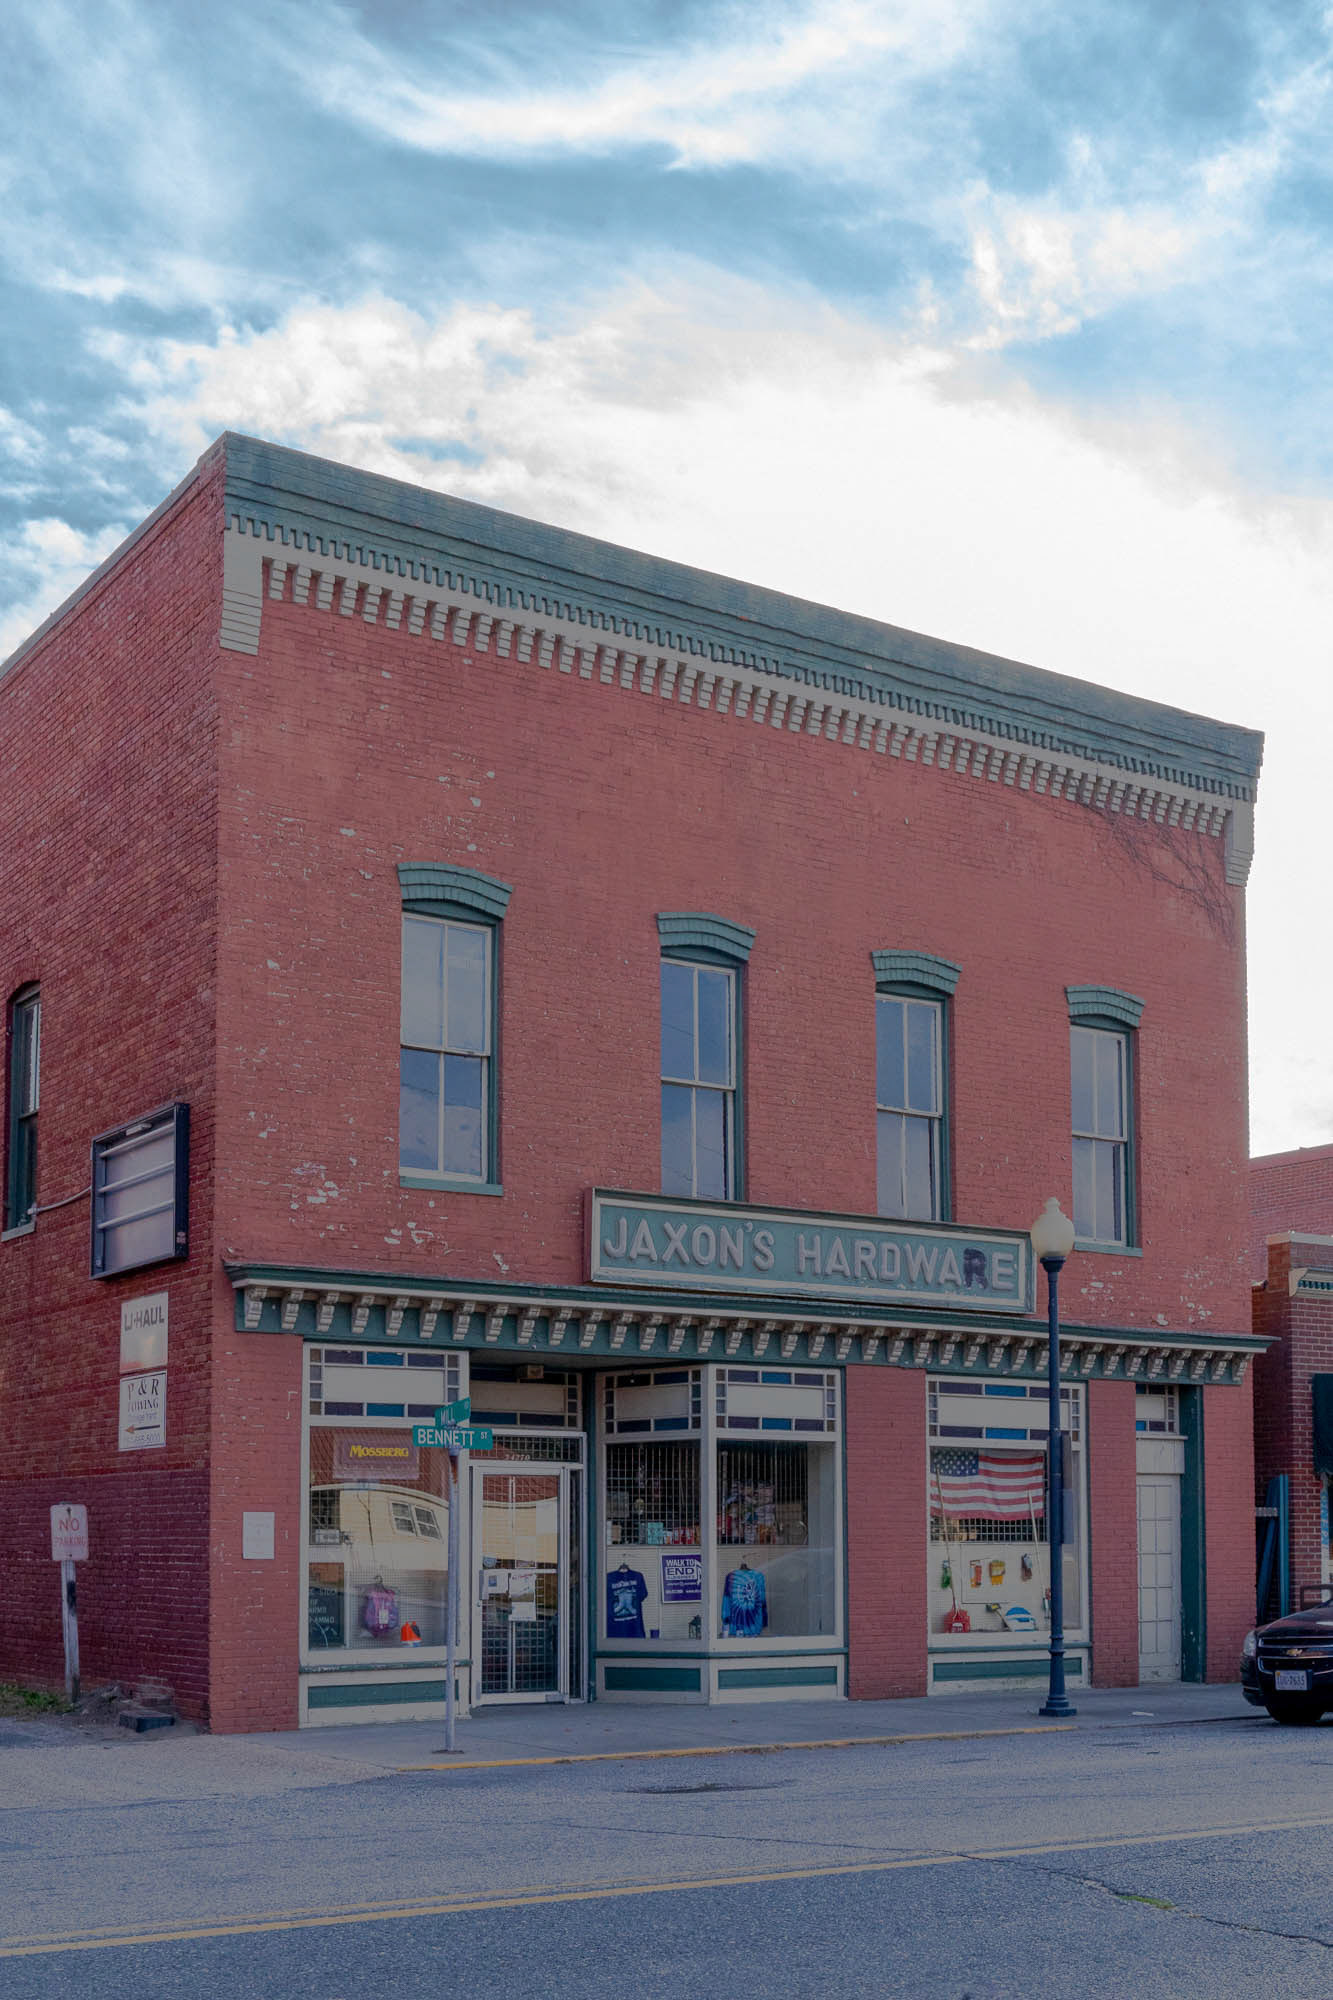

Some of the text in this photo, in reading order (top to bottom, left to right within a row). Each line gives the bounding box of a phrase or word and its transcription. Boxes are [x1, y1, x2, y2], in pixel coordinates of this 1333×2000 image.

[604, 1216, 1016, 1291] JAXON'S HARDWARE
[127, 1378, 159, 1401] P & R
[417, 1428, 488, 1449] BENNETT ST
[58, 1517, 80, 1532] NO
[666, 1559, 685, 1567] WALK
[666, 1567, 695, 1576] END
